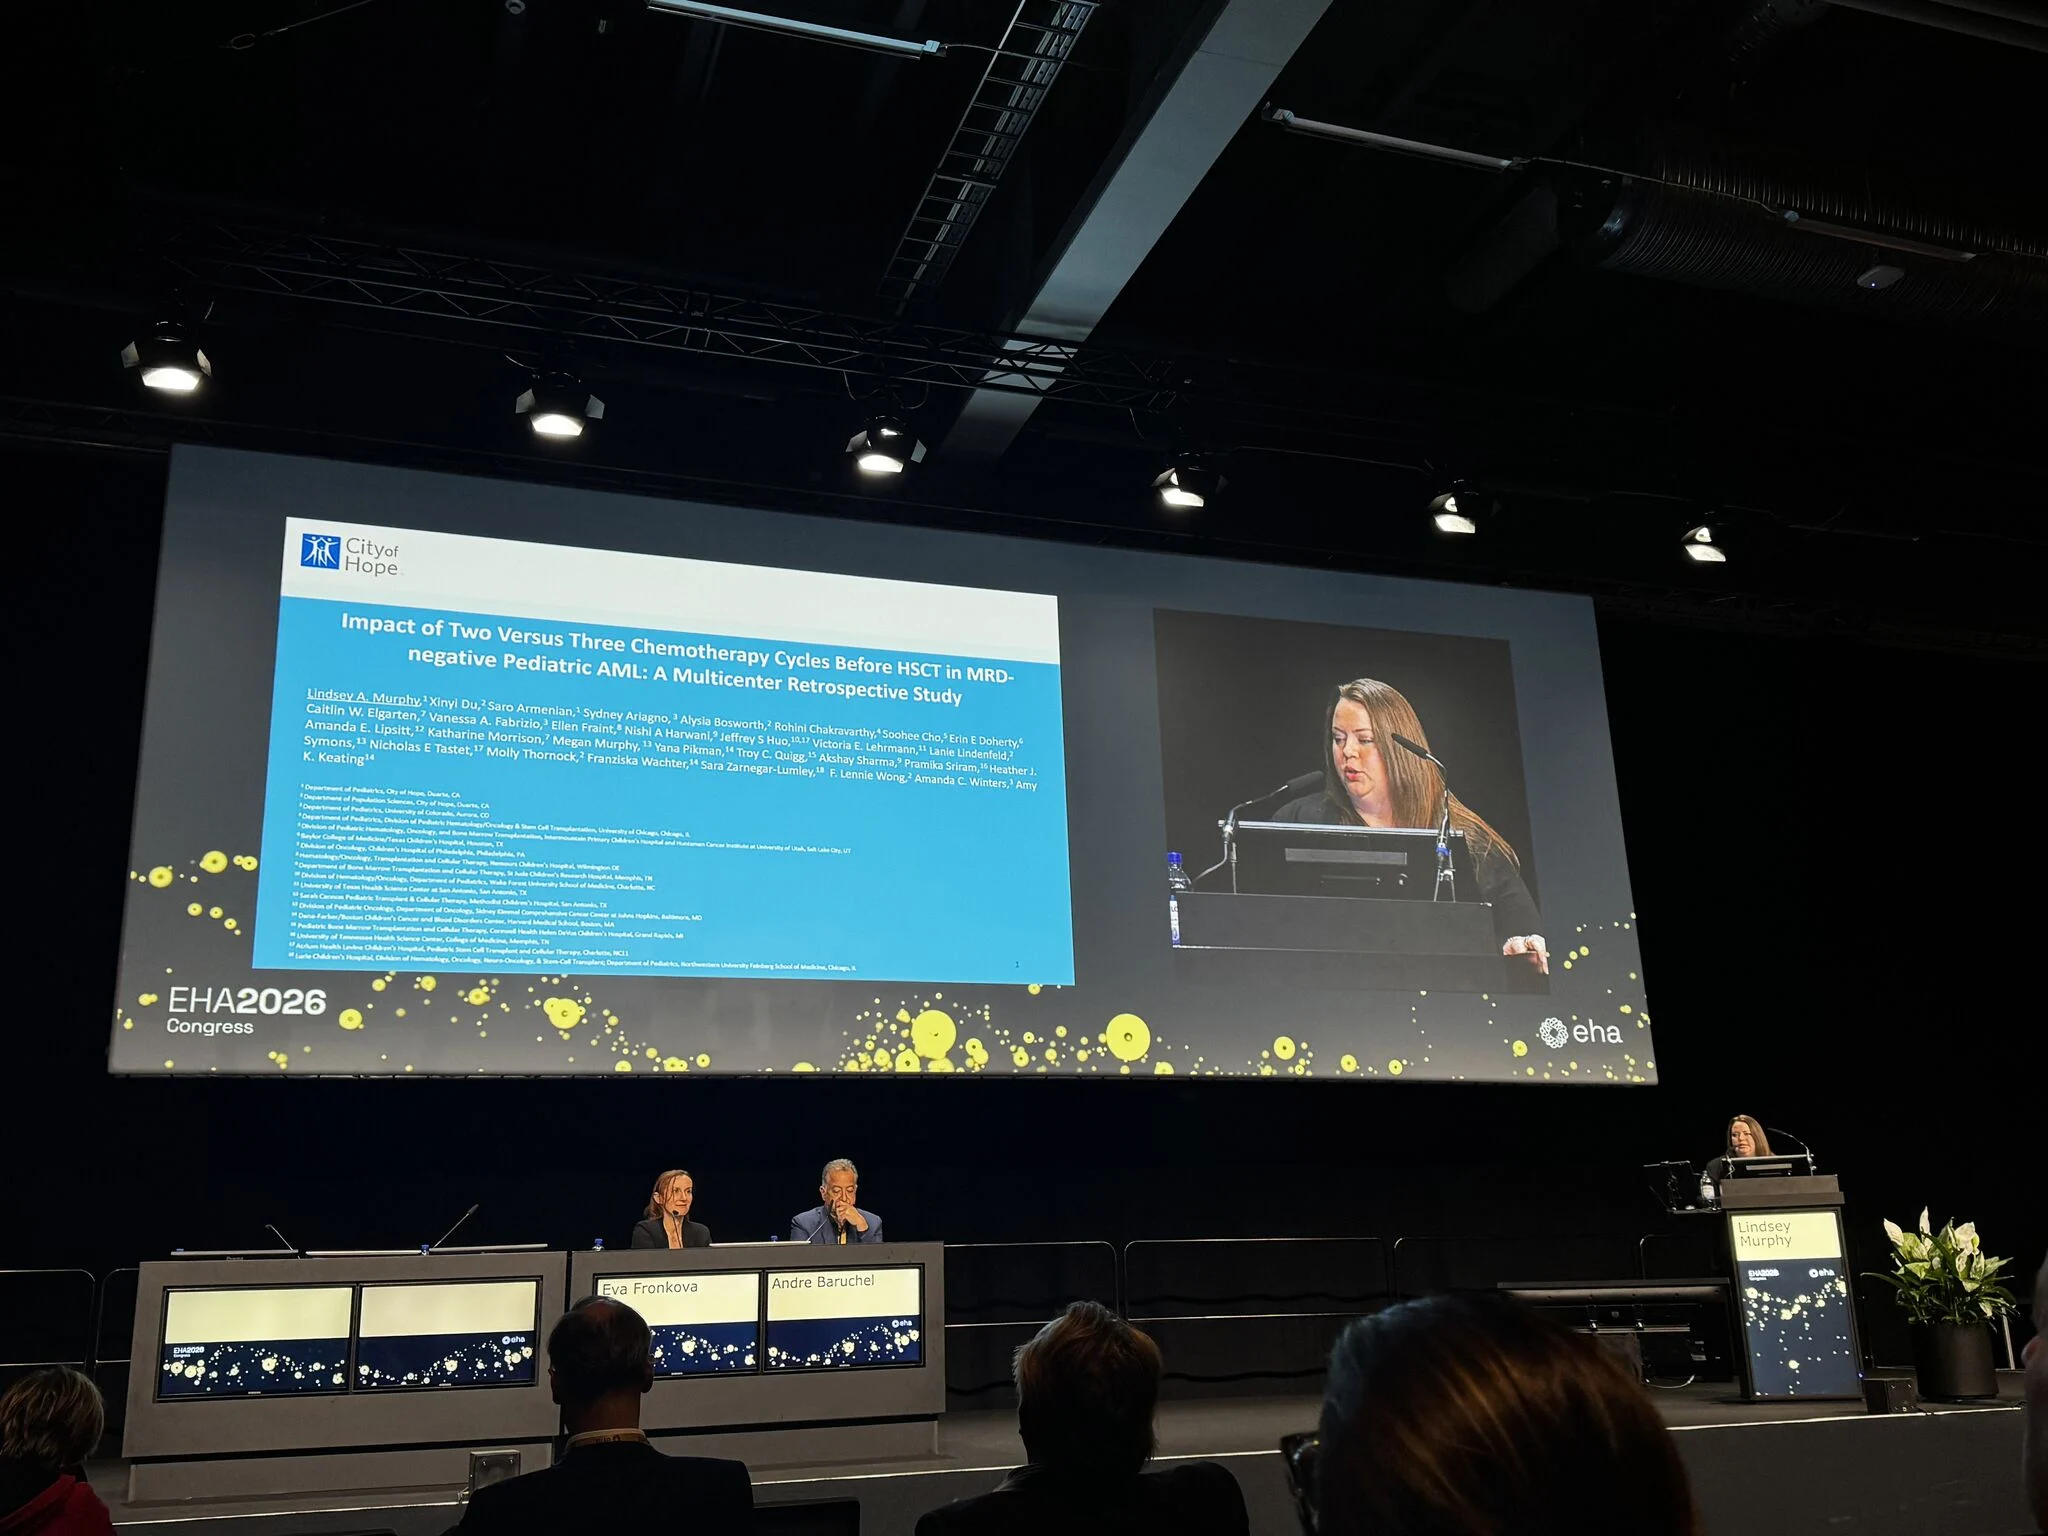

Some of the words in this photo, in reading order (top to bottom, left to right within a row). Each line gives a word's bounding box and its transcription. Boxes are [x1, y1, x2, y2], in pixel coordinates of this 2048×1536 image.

[346, 537, 385, 559] City
[345, 556, 398, 577] Hope
[341, 612, 416, 635] Impact
[421, 620, 444, 637] of
[448, 622, 492, 641] Two
[498, 627, 564, 647] Versus
[570, 633, 626, 652] Three
[630, 639, 770, 668] Chemotherapy
[774, 651, 830, 670] Cycles
[835, 656, 893, 675] Before
[897, 662, 942, 678] HSCT
[946, 665, 962, 680] in
[966, 667, 1015, 684] MRD-
[408, 648, 498, 668] negative
[503, 653, 593, 676] Pediatric
[596, 660, 648, 680] AML:
[652, 665, 668, 682] A
[672, 667, 783, 691] Multicenter
[787, 676, 909, 701] Retrospective
[912, 686, 963, 708] Study
[307, 688, 354, 703] Lindsey
[429, 696, 458, 710] Xinyi
[487, 700, 514, 713] Saro
[583, 707, 624, 722] Sydney
[625, 711, 672, 725] Ariagno,
[679, 714, 712, 727] Alysia
[774, 721, 807, 733] Rohini
[882, 729, 920, 741] Soohee
[949, 734, 969, 744] Erin
[306, 703, 345, 716] Caitlin
[428, 711, 477, 725] Vanessa
[551, 720, 579, 732] Ellen
[624, 725, 652, 737] Nishi
[719, 732, 756, 746] Jeffrey
[812, 738, 852, 750] Victoria
[929, 746, 955, 757] Lanie
[304, 719, 357, 732] Amanda
[427, 727, 485, 741] Katharine
[552, 735, 592, 749] Megan
[594, 738, 641, 753] Murphy,
[654, 742, 680, 754] Yana
[736, 747, 760, 761] Troy
[818, 752, 855, 767] Akshay
[904, 758, 944, 770] Pramika
[989, 764, 1028, 776] Heather
[369, 739, 422, 753] Nicholas
[486, 746, 520, 761] Molly
[587, 752, 639, 766] Franziska
[700, 760, 725, 771] Sara
[840, 769, 874, 781] Lennie
[914, 773, 955, 786] Amanda
[1015, 780, 1038, 792] Amy
[168, 986, 327, 1015] EHA2026
[166, 1018, 254, 1036] Congress
[1573, 1018, 1624, 1044] eha
[1738, 1221, 1791, 1234] Lindsey
[1740, 1234, 1792, 1249] Murphy
[602, 1283, 628, 1296] Eva
[633, 1281, 698, 1295] Fronkova
[772, 1277, 812, 1290] Andre
[817, 1274, 875, 1288] Baruchel
